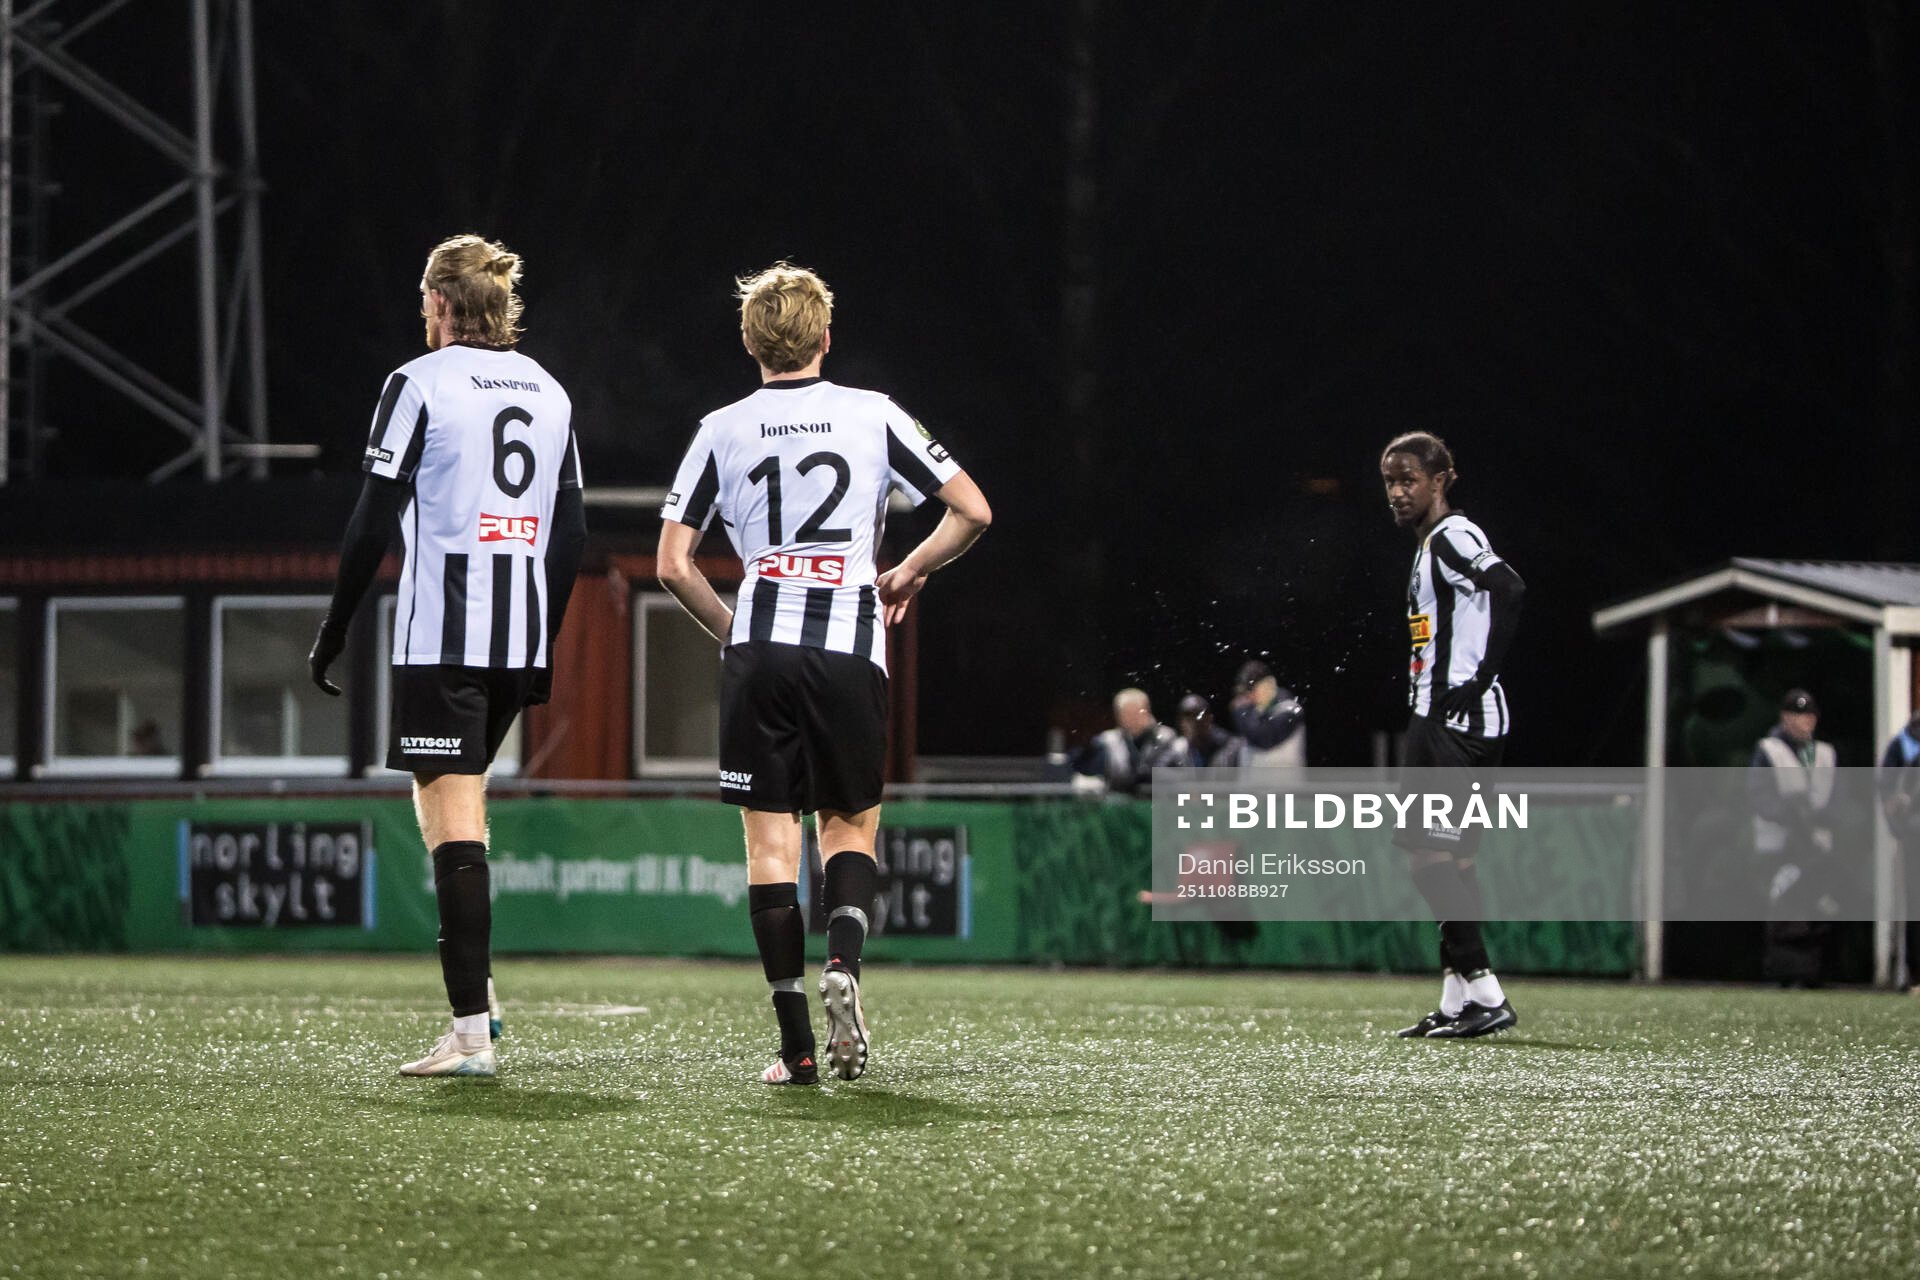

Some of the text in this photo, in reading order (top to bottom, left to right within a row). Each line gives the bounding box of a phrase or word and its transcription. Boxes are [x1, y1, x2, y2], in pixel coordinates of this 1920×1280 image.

[493, 406, 536, 499] 6
[760, 422, 832, 439] Jonsson
[747, 451, 852, 546] 12
[479, 517, 537, 540] PULS
[759, 555, 843, 580] PULS
[191, 822, 359, 879] norling
[215, 871, 337, 928] skylt
